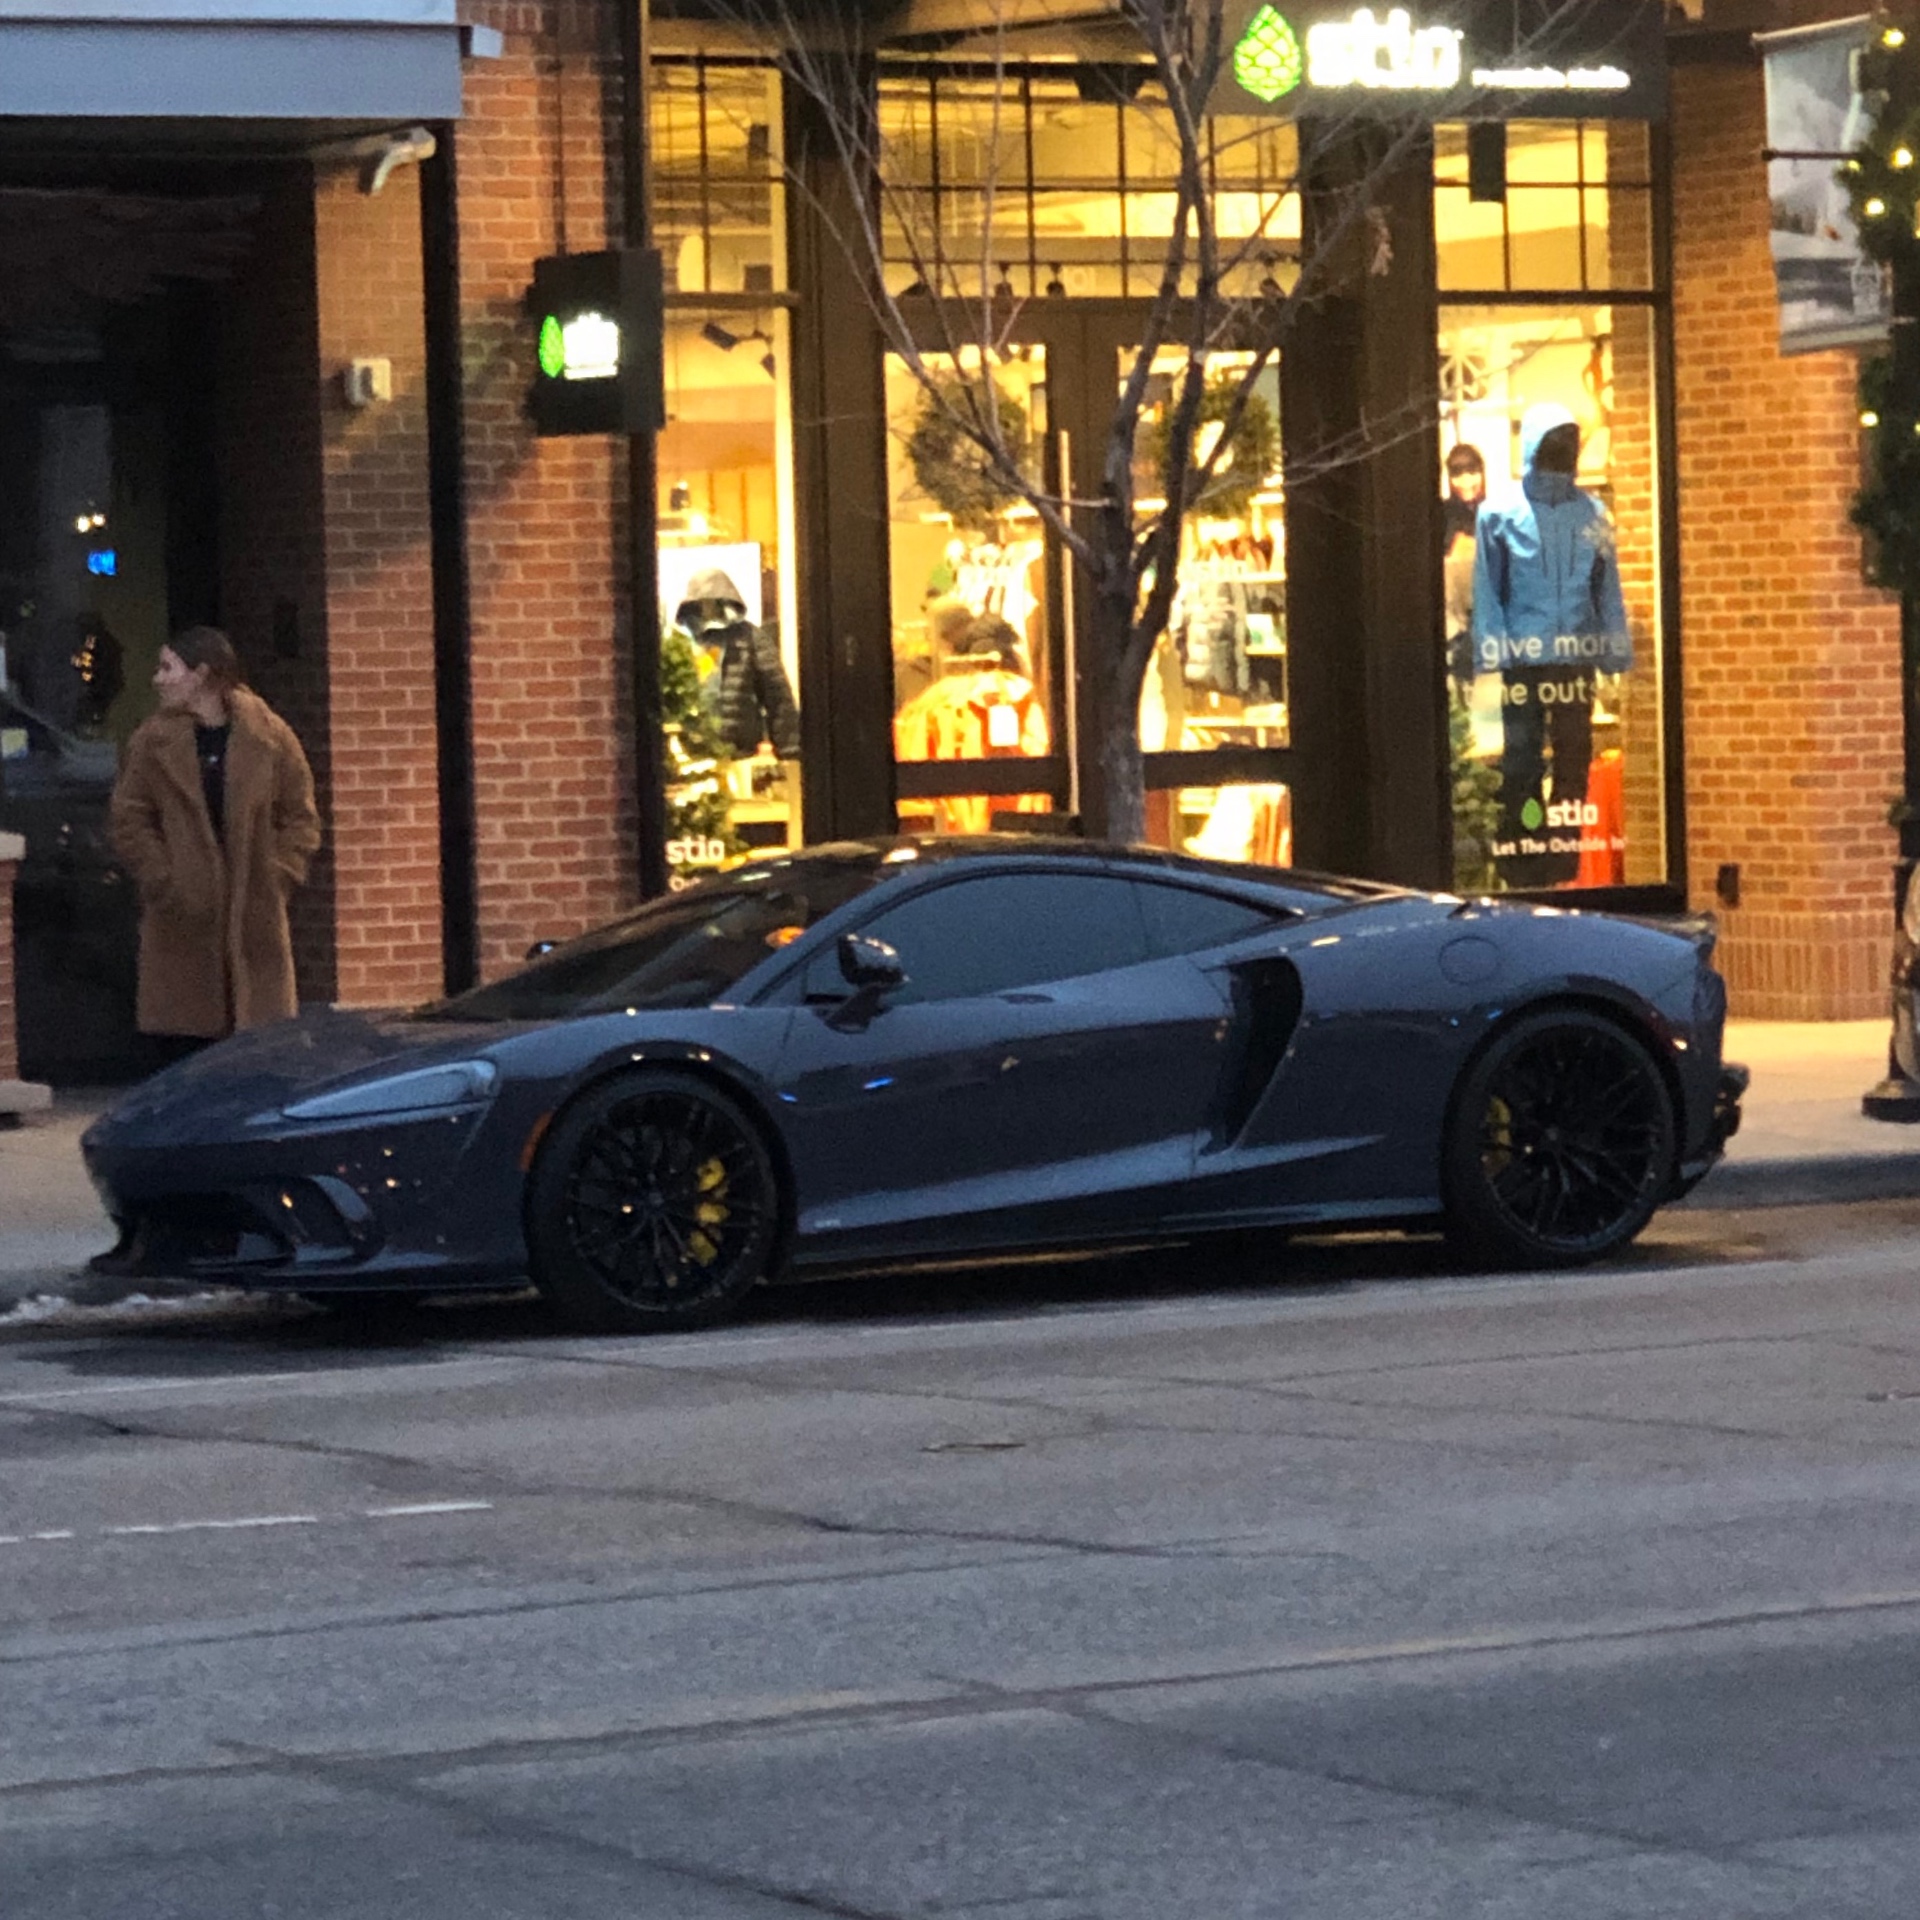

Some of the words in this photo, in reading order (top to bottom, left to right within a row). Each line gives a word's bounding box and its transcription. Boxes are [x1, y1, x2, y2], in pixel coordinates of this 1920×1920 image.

[1481, 631, 1543, 668] give
[1555, 634, 1627, 656] more
[1547, 799, 1598, 827] stio
[665, 834, 725, 864] stio
[1491, 840, 1516, 856] Let
[1520, 837, 1547, 853] The
[1549, 835, 1607, 852] Outside
